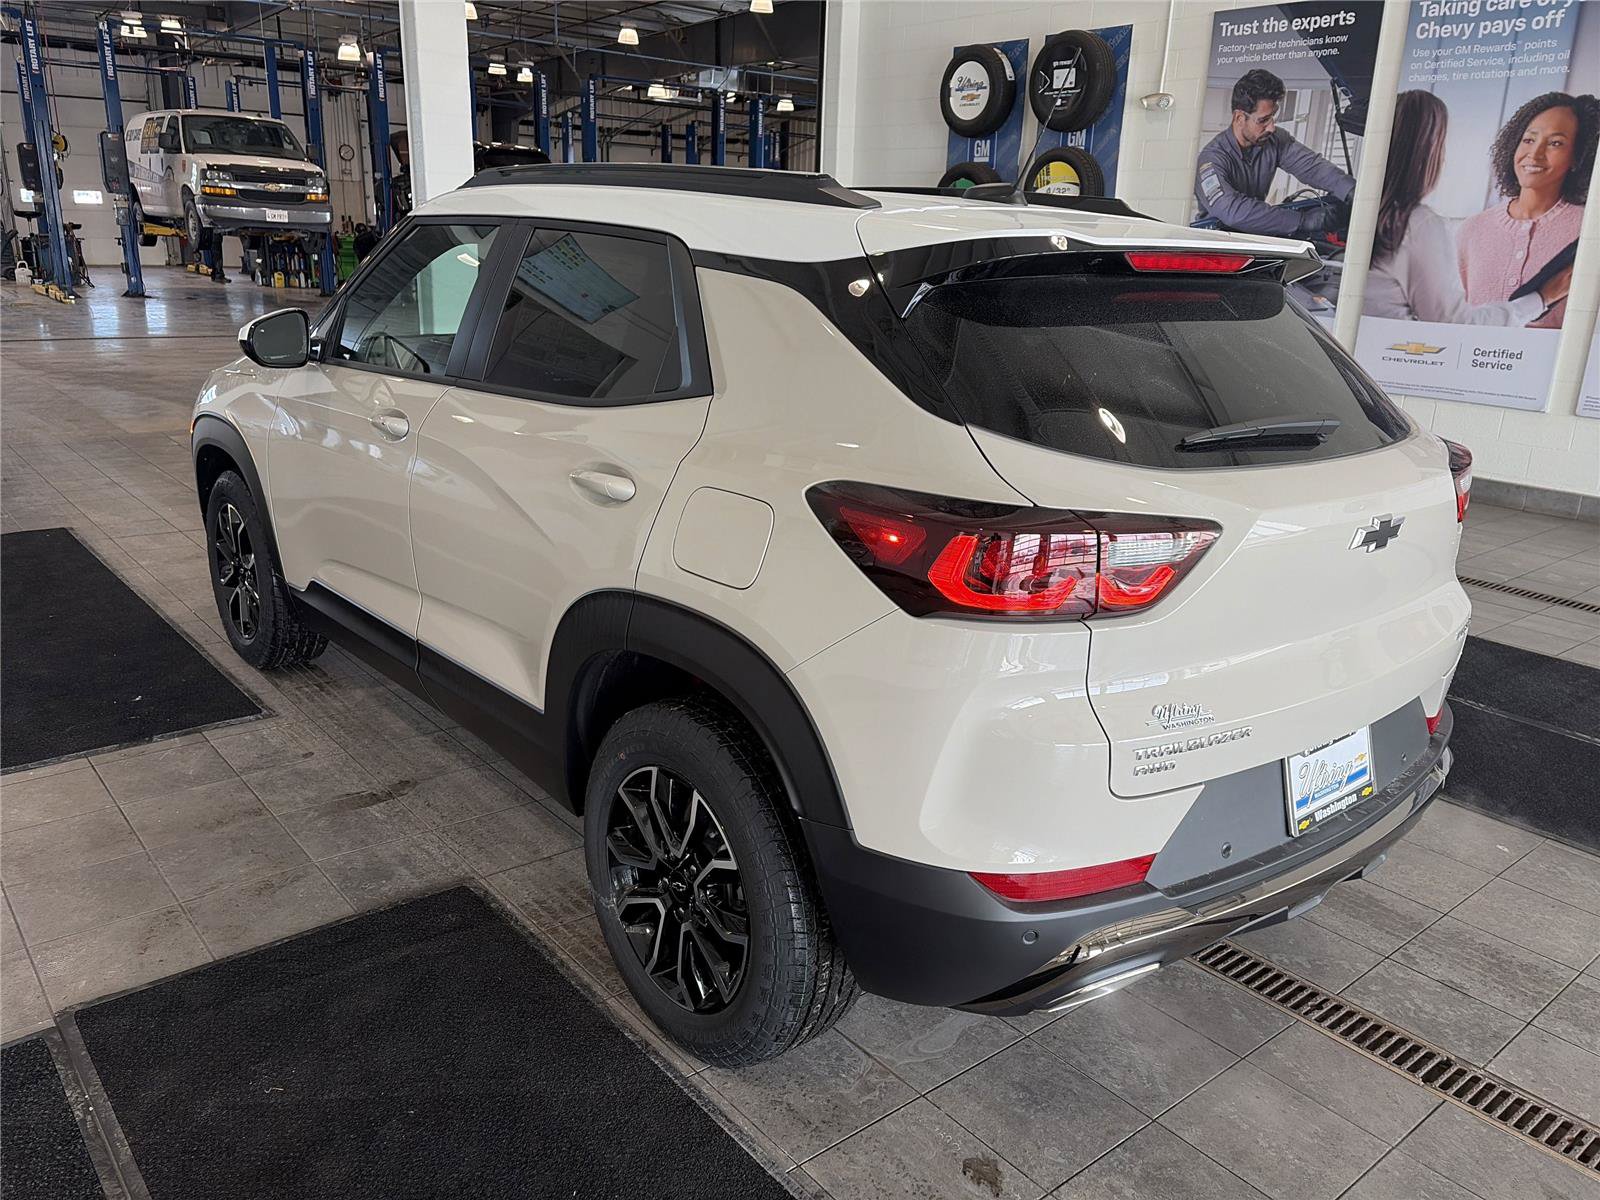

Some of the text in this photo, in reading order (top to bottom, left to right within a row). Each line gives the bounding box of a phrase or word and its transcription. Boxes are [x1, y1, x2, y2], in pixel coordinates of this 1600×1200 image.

[1419, 0, 1481, 18] Taking
[1219, 10, 1356, 37] Trust the experts
[1415, 9, 1566, 40] Chevy pays off
[25, 19, 39, 70] ROTARY LIFT
[1218, 34, 1349, 53] Factory-trained technicians know
[1412, 48, 1430, 57] Use
[1431, 49, 1454, 60] your
[1455, 45, 1472, 55] GM
[1524, 38, 1557, 51] points
[104, 45, 114, 77] ROTARY
[1217, 47, 1340, 66] your vehicle better than anyone.
[1410, 50, 1571, 70] on Certified Service, including oil
[308, 67, 316, 95] ROTARY
[377, 70, 385, 98] ROTARY
[1408, 65, 1571, 84] changes, tire rotations and more.
[21, 76, 31, 100] ROTARY
[1067, 128, 1087, 147] GM
[974, 139, 991, 157] GM
[1381, 355, 1445, 367] CHEVROLET
[1473, 347, 1523, 360] Certified
[1471, 359, 1513, 371] Service
[1162, 716, 1215, 731] WASHINGTON
[1133, 725, 1253, 760] TRAILBLAZER
[1133, 760, 1176, 777] AWD
[1314, 793, 1358, 822] Washington
